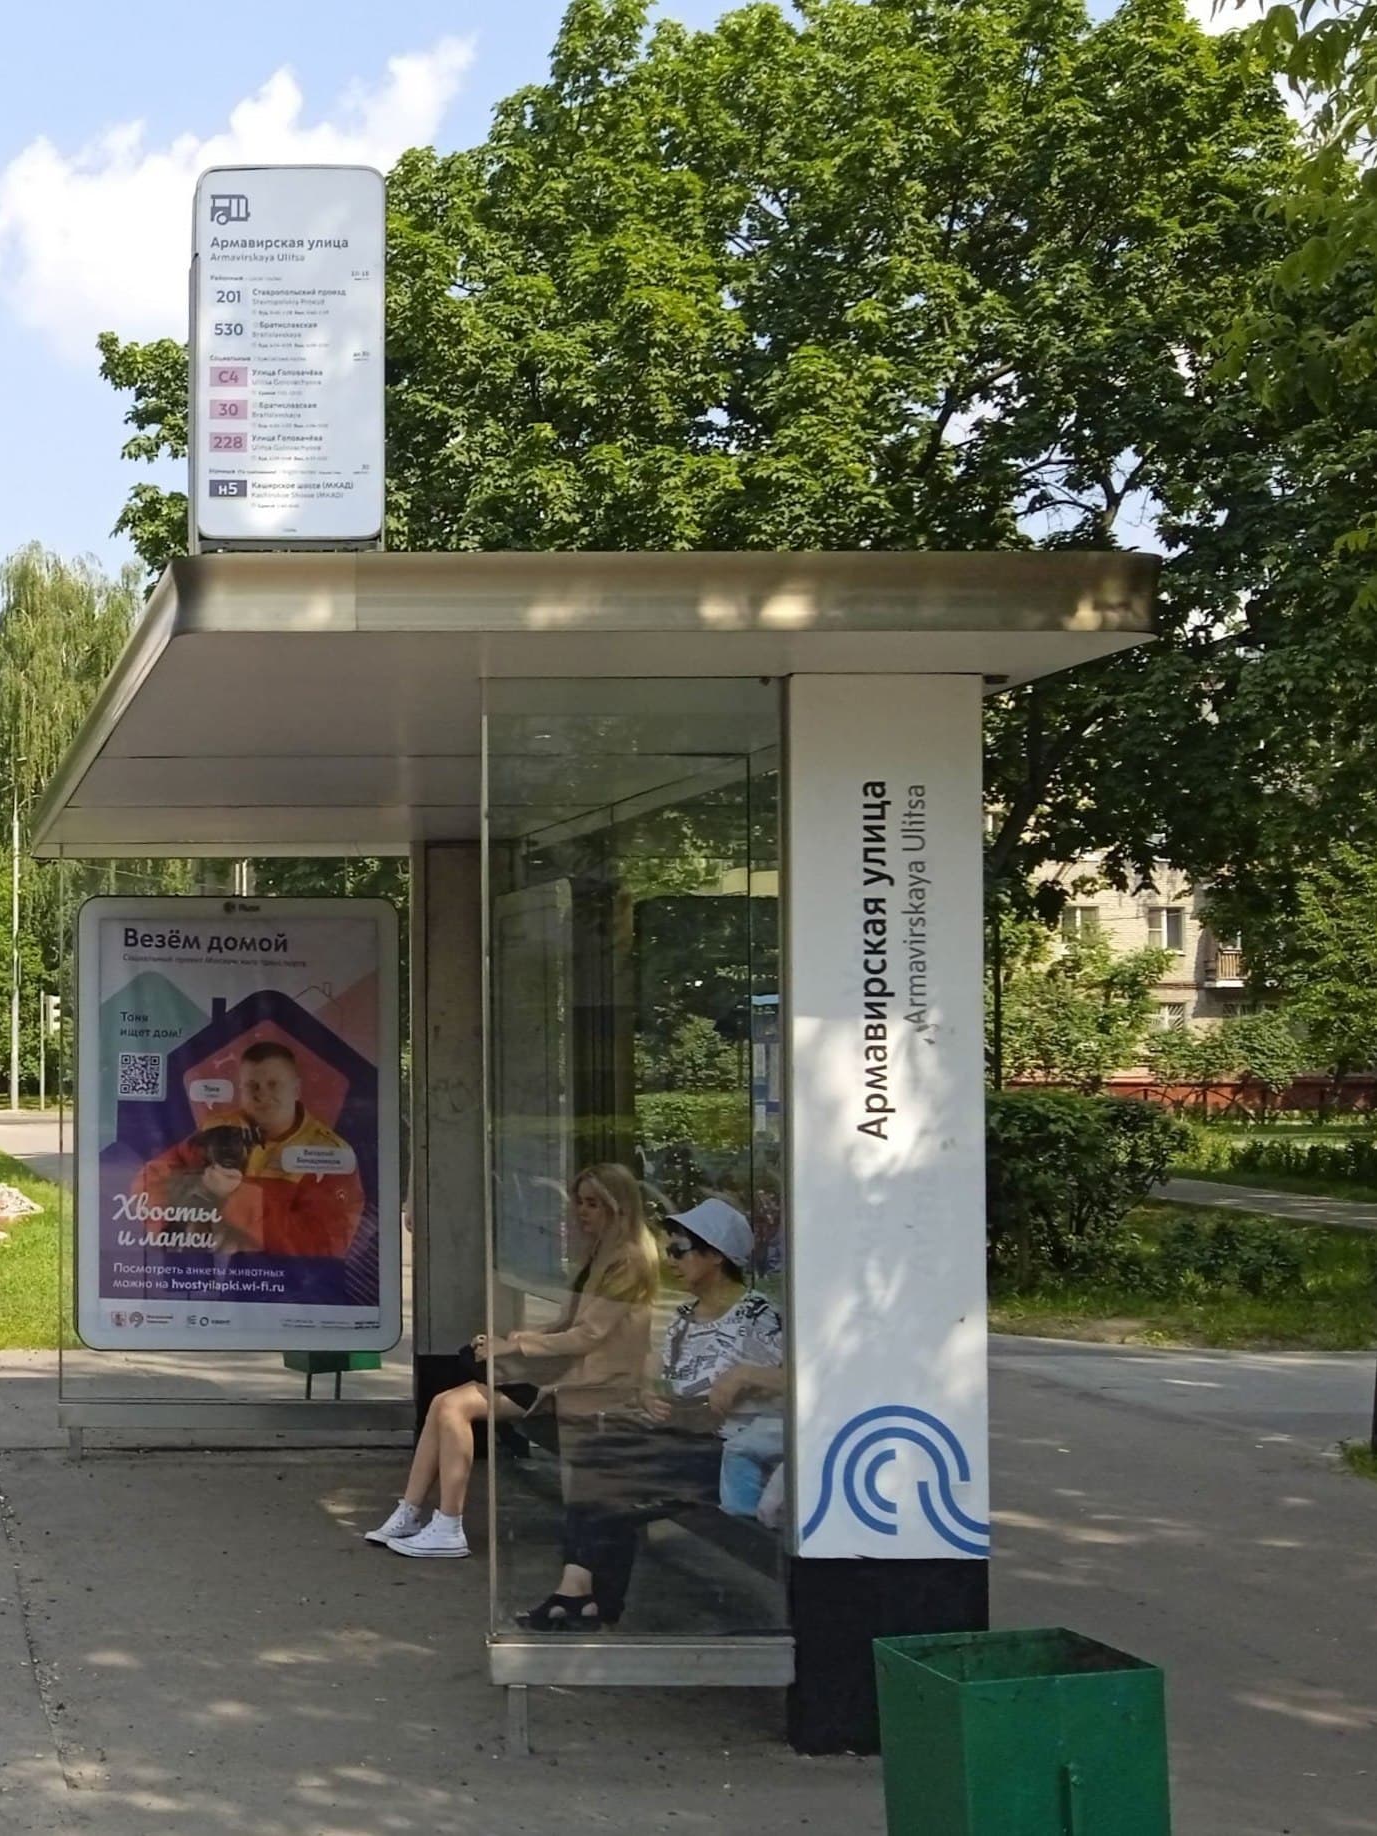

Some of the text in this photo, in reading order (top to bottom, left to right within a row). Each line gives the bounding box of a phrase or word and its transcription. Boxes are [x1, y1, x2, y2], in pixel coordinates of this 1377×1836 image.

[210, 236, 349, 251] Армавирская улица
[210, 253, 305, 263] Armavirskaya Ulitsa
[216, 290, 241, 303] 201
[214, 323, 244, 336] 530
[218, 370, 240, 384] С4
[219, 403, 239, 417] 30
[213, 436, 244, 450] 228
[900, 784, 932, 1025] Armavirskaya Ulitsa
[124, 927, 288, 953] Везём домой
[856, 780, 896, 1141] Армавирская улица
[120, 1011, 149, 1022] Тоня
[120, 1027, 182, 1039] ищет дом!
[112, 1192, 222, 1223] Хвосты
[118, 1231, 217, 1248] и лапки
[113, 1262, 285, 1277] Посмотреть анкеты животных
[112, 1279, 285, 1293] можно на hvostyilapki.wi-fi.ru
